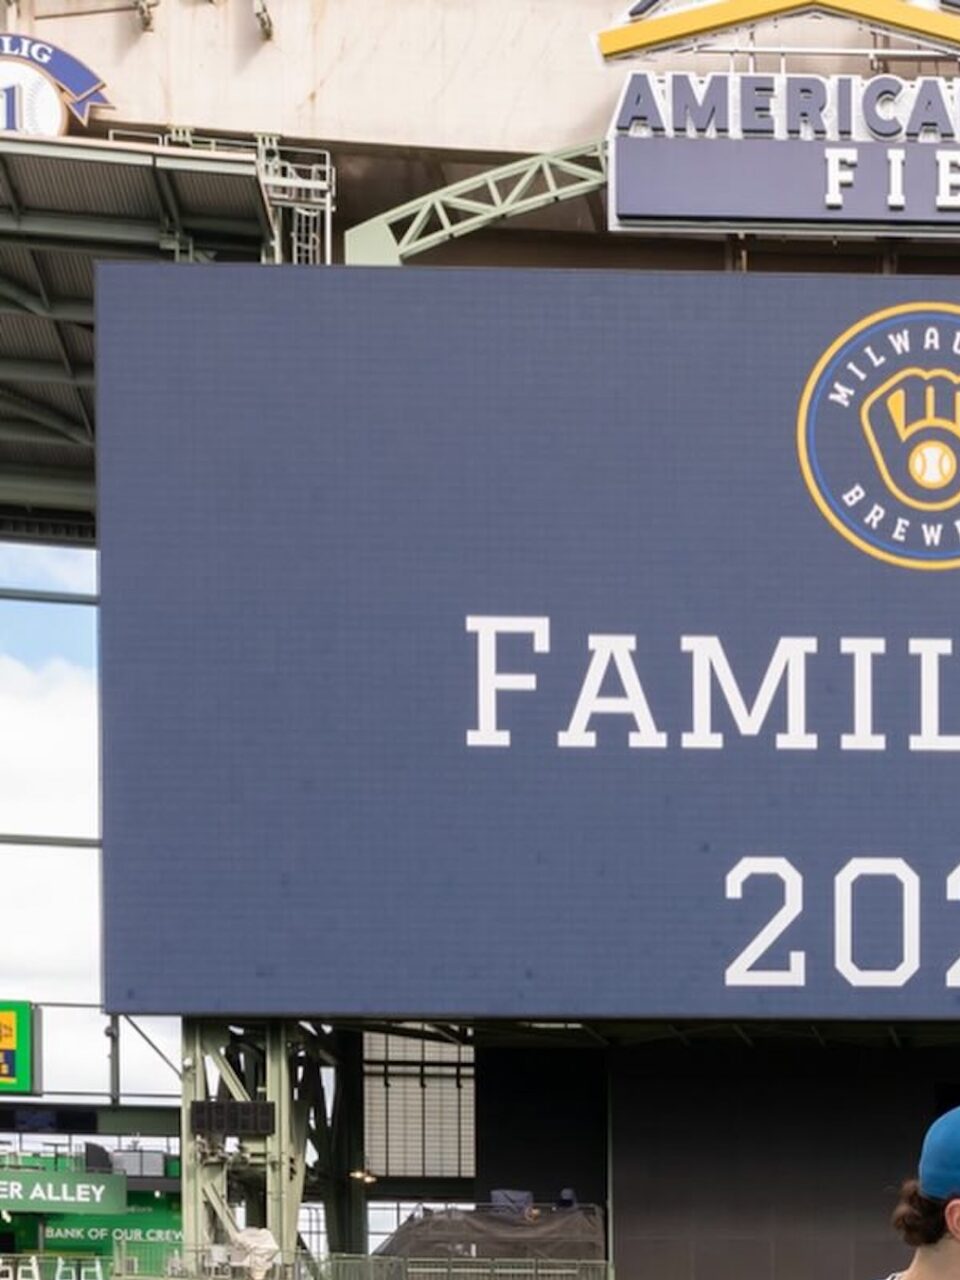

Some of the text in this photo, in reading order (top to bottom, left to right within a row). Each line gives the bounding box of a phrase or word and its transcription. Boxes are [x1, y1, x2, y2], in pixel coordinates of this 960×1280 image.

[29, 1182, 106, 1203] ALLEY
[45, 1227, 85, 1239] BANK
[87, 1228, 108, 1240] OF
[112, 1228, 142, 1241] OUR
